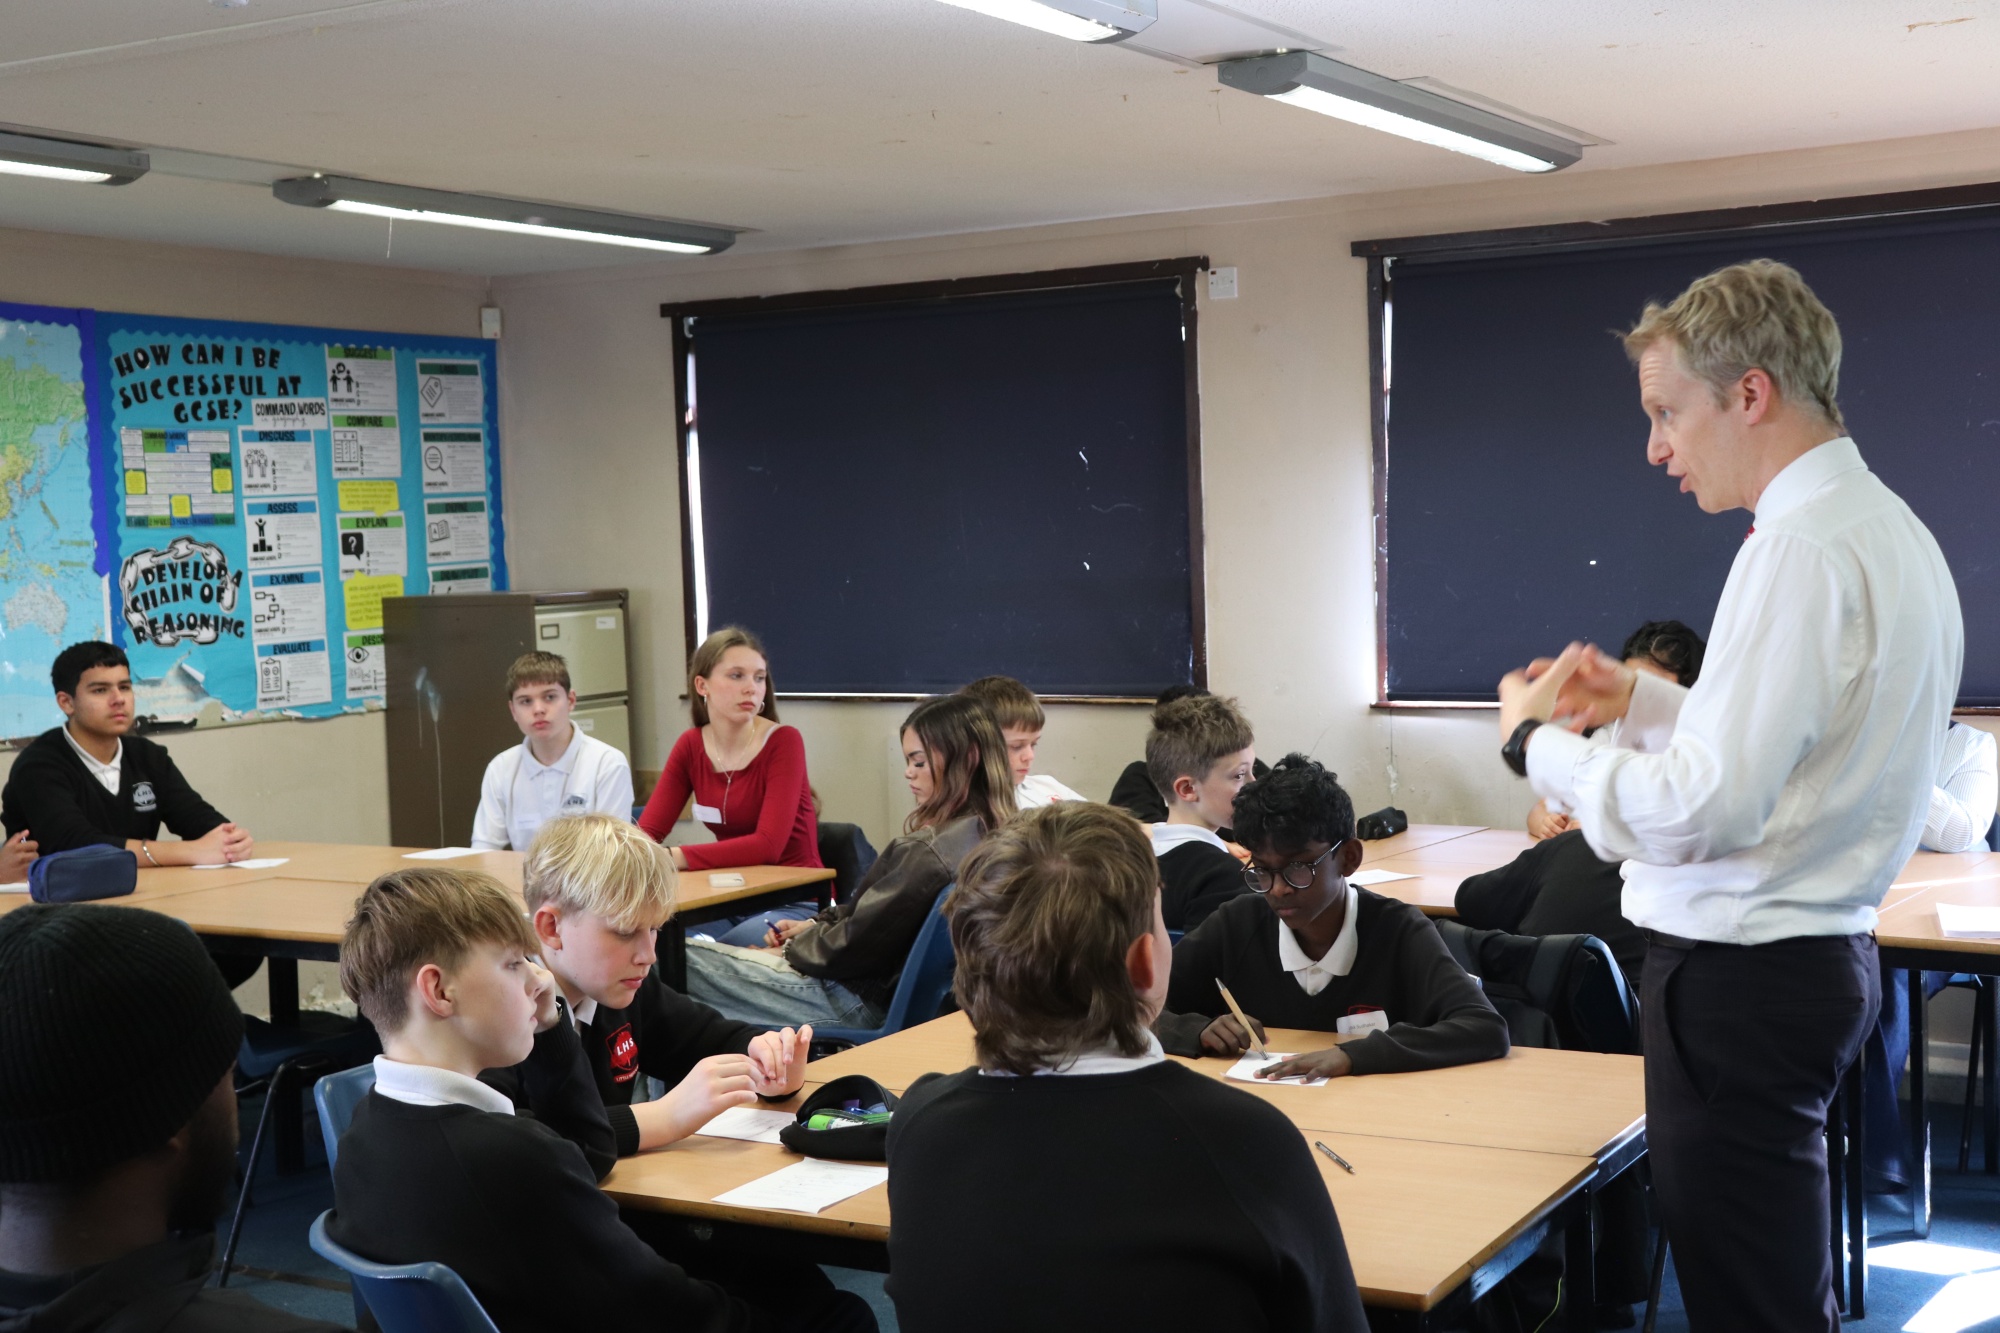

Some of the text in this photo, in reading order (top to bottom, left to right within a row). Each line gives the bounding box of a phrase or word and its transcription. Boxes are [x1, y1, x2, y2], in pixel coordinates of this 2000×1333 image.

[114, 342, 281, 377] HOW CAN I BE
[118, 373, 302, 410] SUCCESSFUL AT
[173, 399, 243, 424] GCSE?
[255, 402, 326, 416] COMMAND WORDS
[346, 415, 383, 427] COMPARE
[258, 430, 296, 442] DISCUSS
[267, 502, 298, 514] ASSESS
[355, 517, 388, 528] EXPLAIN
[141, 561, 243, 588] DEVELOP A
[270, 572, 305, 586] EXAMINE
[130, 583, 225, 613] CHAIN OF
[133, 612, 245, 645] REASONING
[273, 641, 312, 655] EVALUATE
[617, 1037, 634, 1056] LHS
